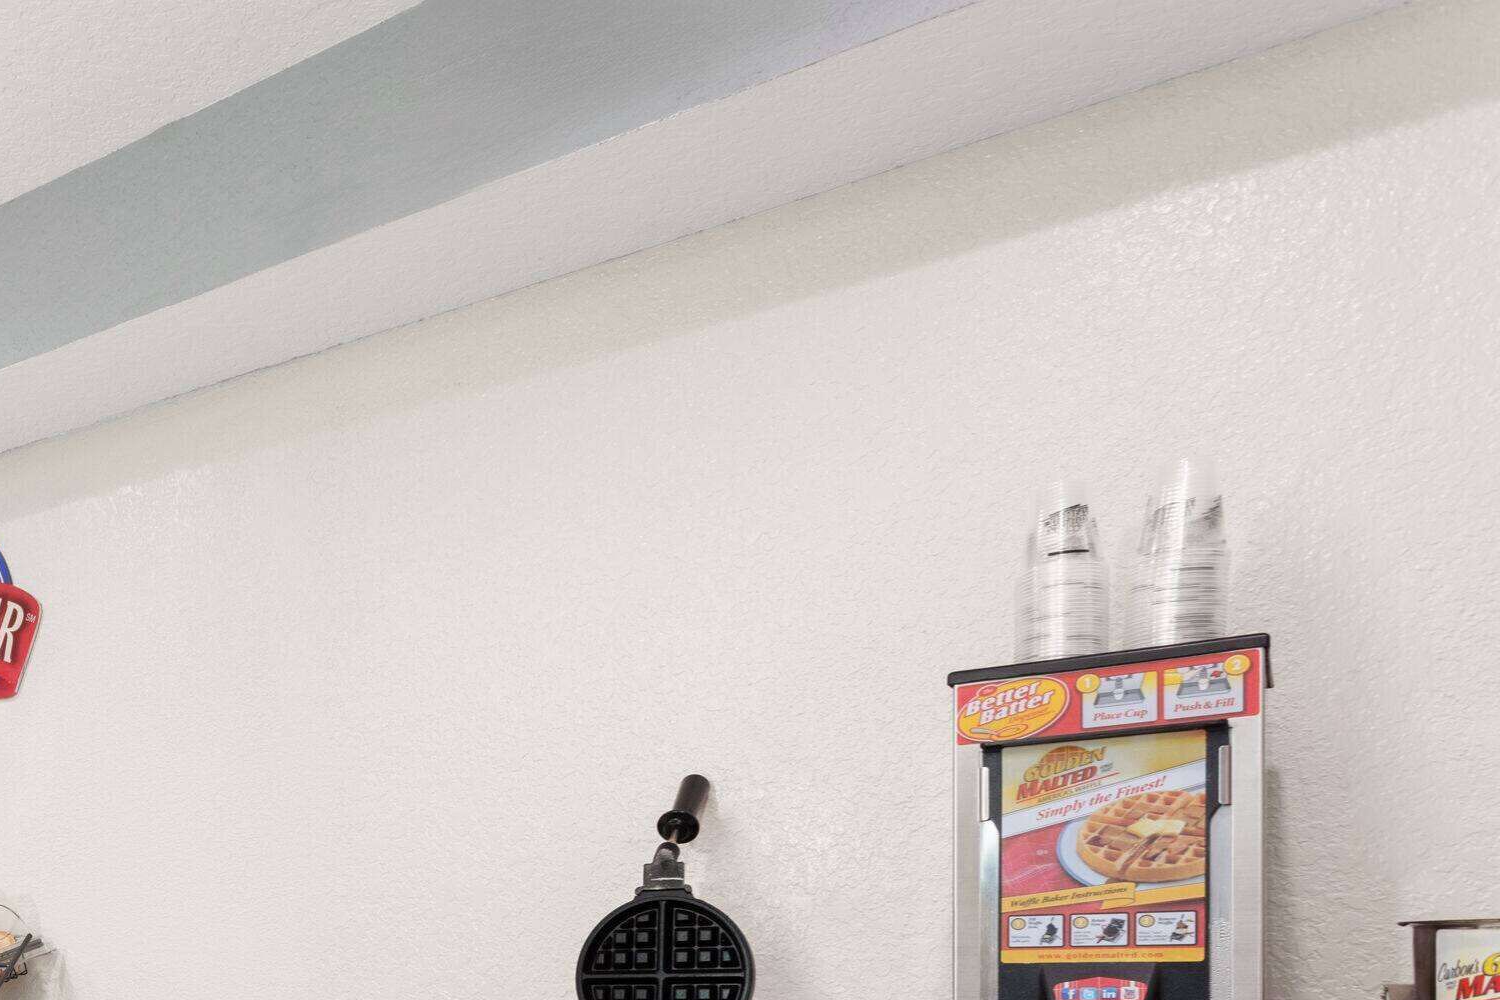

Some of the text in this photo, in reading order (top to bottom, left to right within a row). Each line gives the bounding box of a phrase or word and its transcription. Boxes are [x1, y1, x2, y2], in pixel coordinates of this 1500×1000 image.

[965, 681, 1041, 717] Better
[979, 690, 1055, 725] Batter
[1092, 708, 1149, 721] Place Cup
[1173, 697, 1236, 713] Push & Fill
[1023, 746, 1108, 783] GOLDEN
[1016, 765, 1099, 801] MALTED
[1037, 776, 1167, 821] Simply the Finest!
[1010, 886, 1128, 908] Waffle Baker Instructions
[1038, 951, 1164, 960] www.goldenmalted.com
